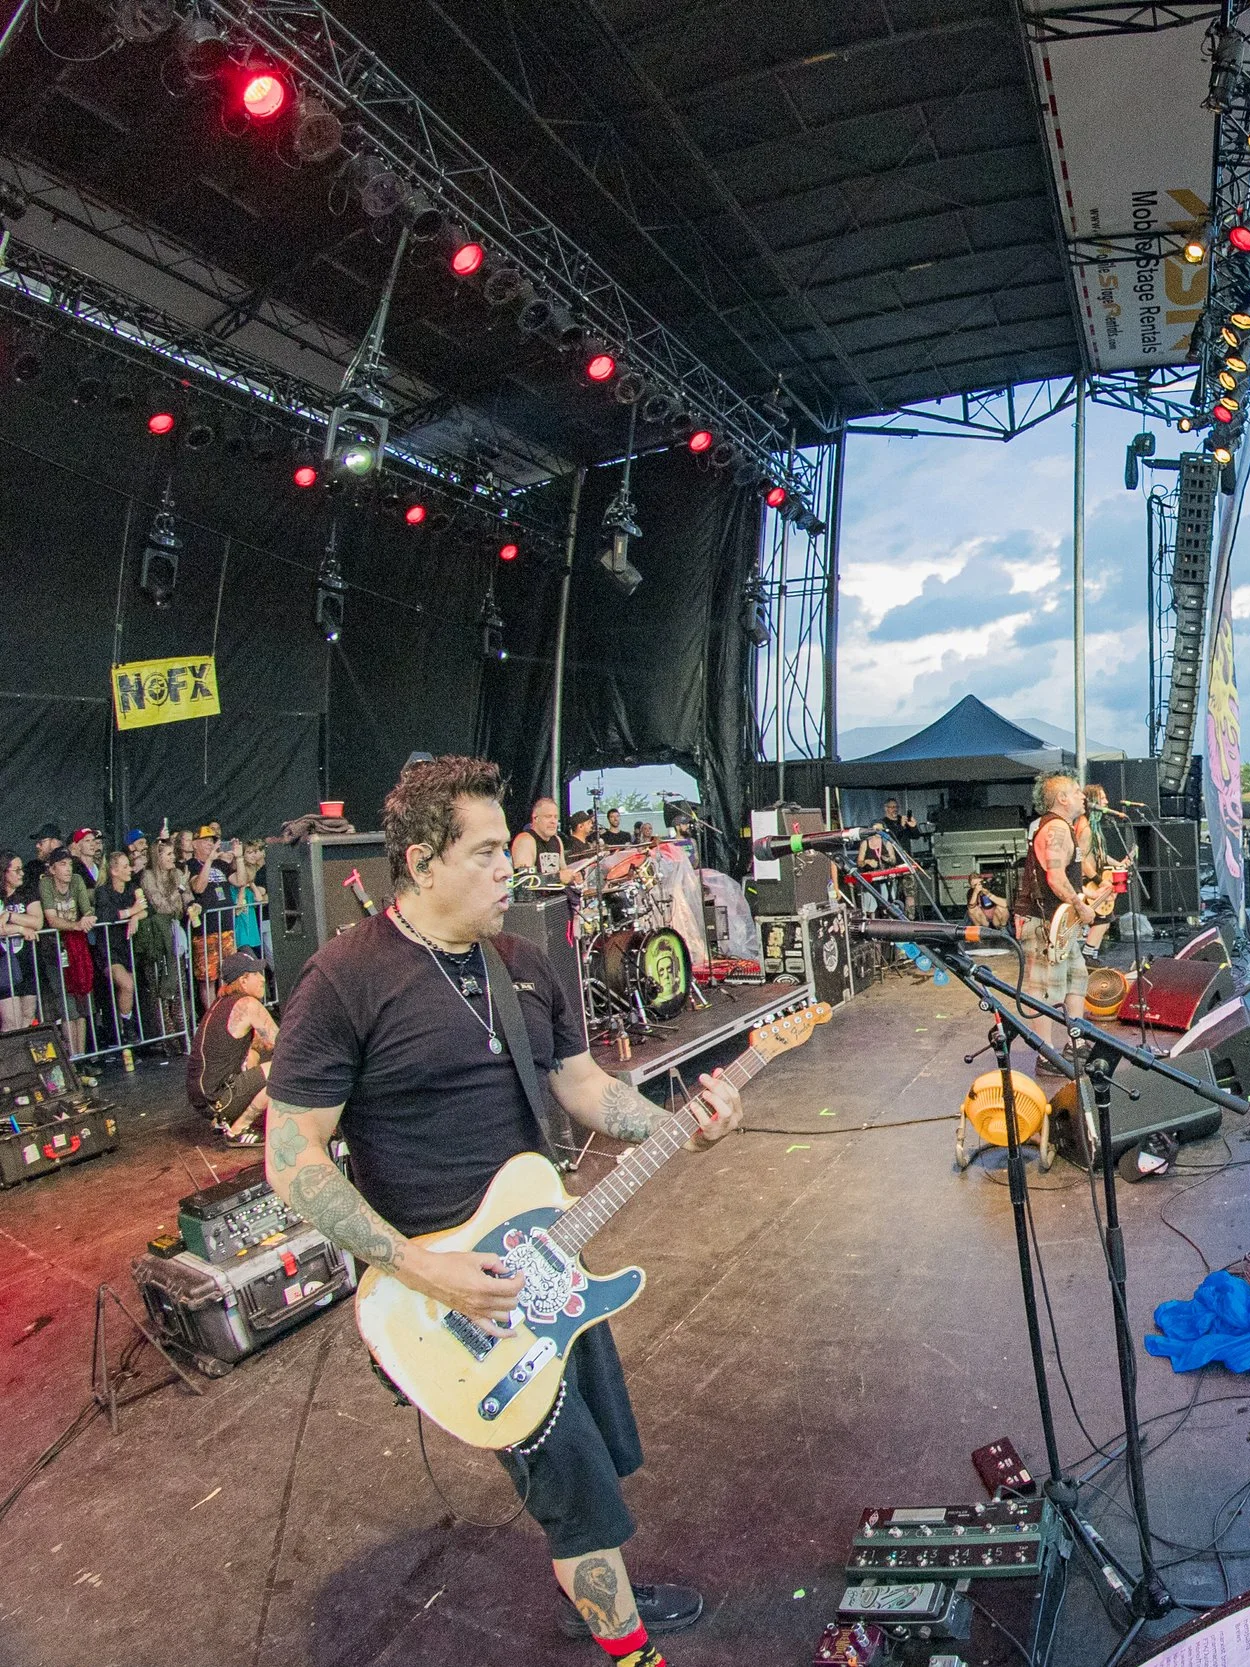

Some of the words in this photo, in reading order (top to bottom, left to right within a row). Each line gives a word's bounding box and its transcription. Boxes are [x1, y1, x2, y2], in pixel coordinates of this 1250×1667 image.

[1131, 190, 1158, 253] Moble
[1132, 256, 1160, 302] Stage
[1138, 305, 1162, 354] Rentals
[116, 664, 214, 714] NOFX
